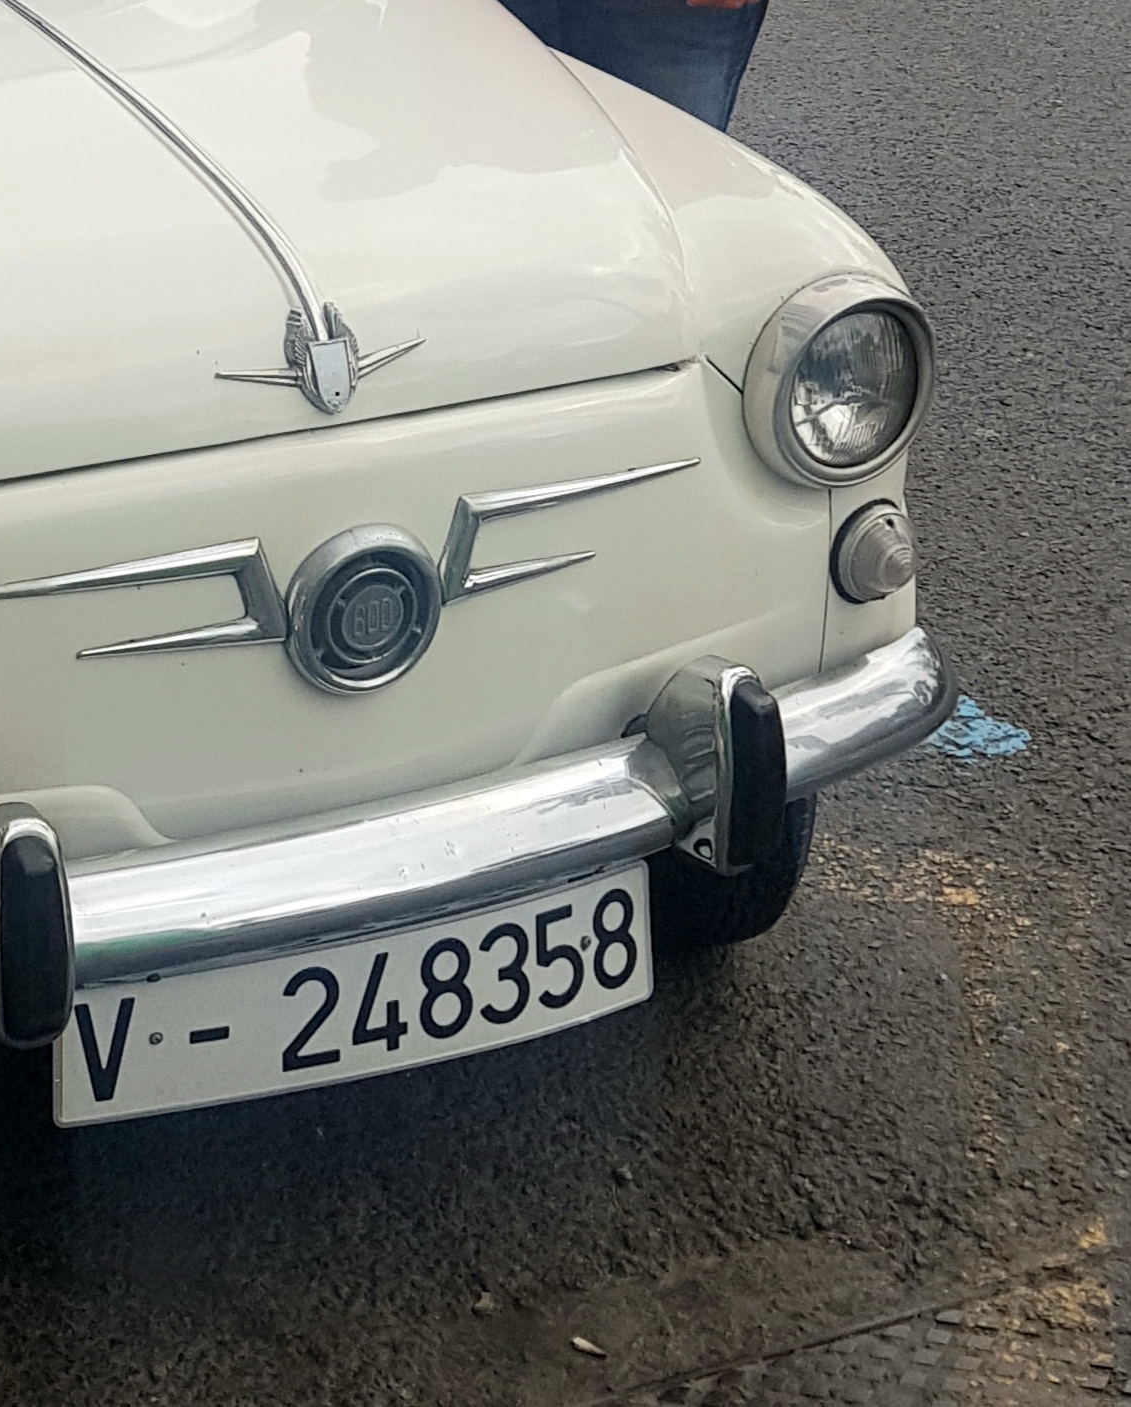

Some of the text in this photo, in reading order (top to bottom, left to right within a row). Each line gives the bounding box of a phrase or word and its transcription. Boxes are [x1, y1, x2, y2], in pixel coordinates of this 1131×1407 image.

[353, 596, 393, 638] 600
[73, 996, 136, 1103] V
[281, 888, 638, 1073] 248358
